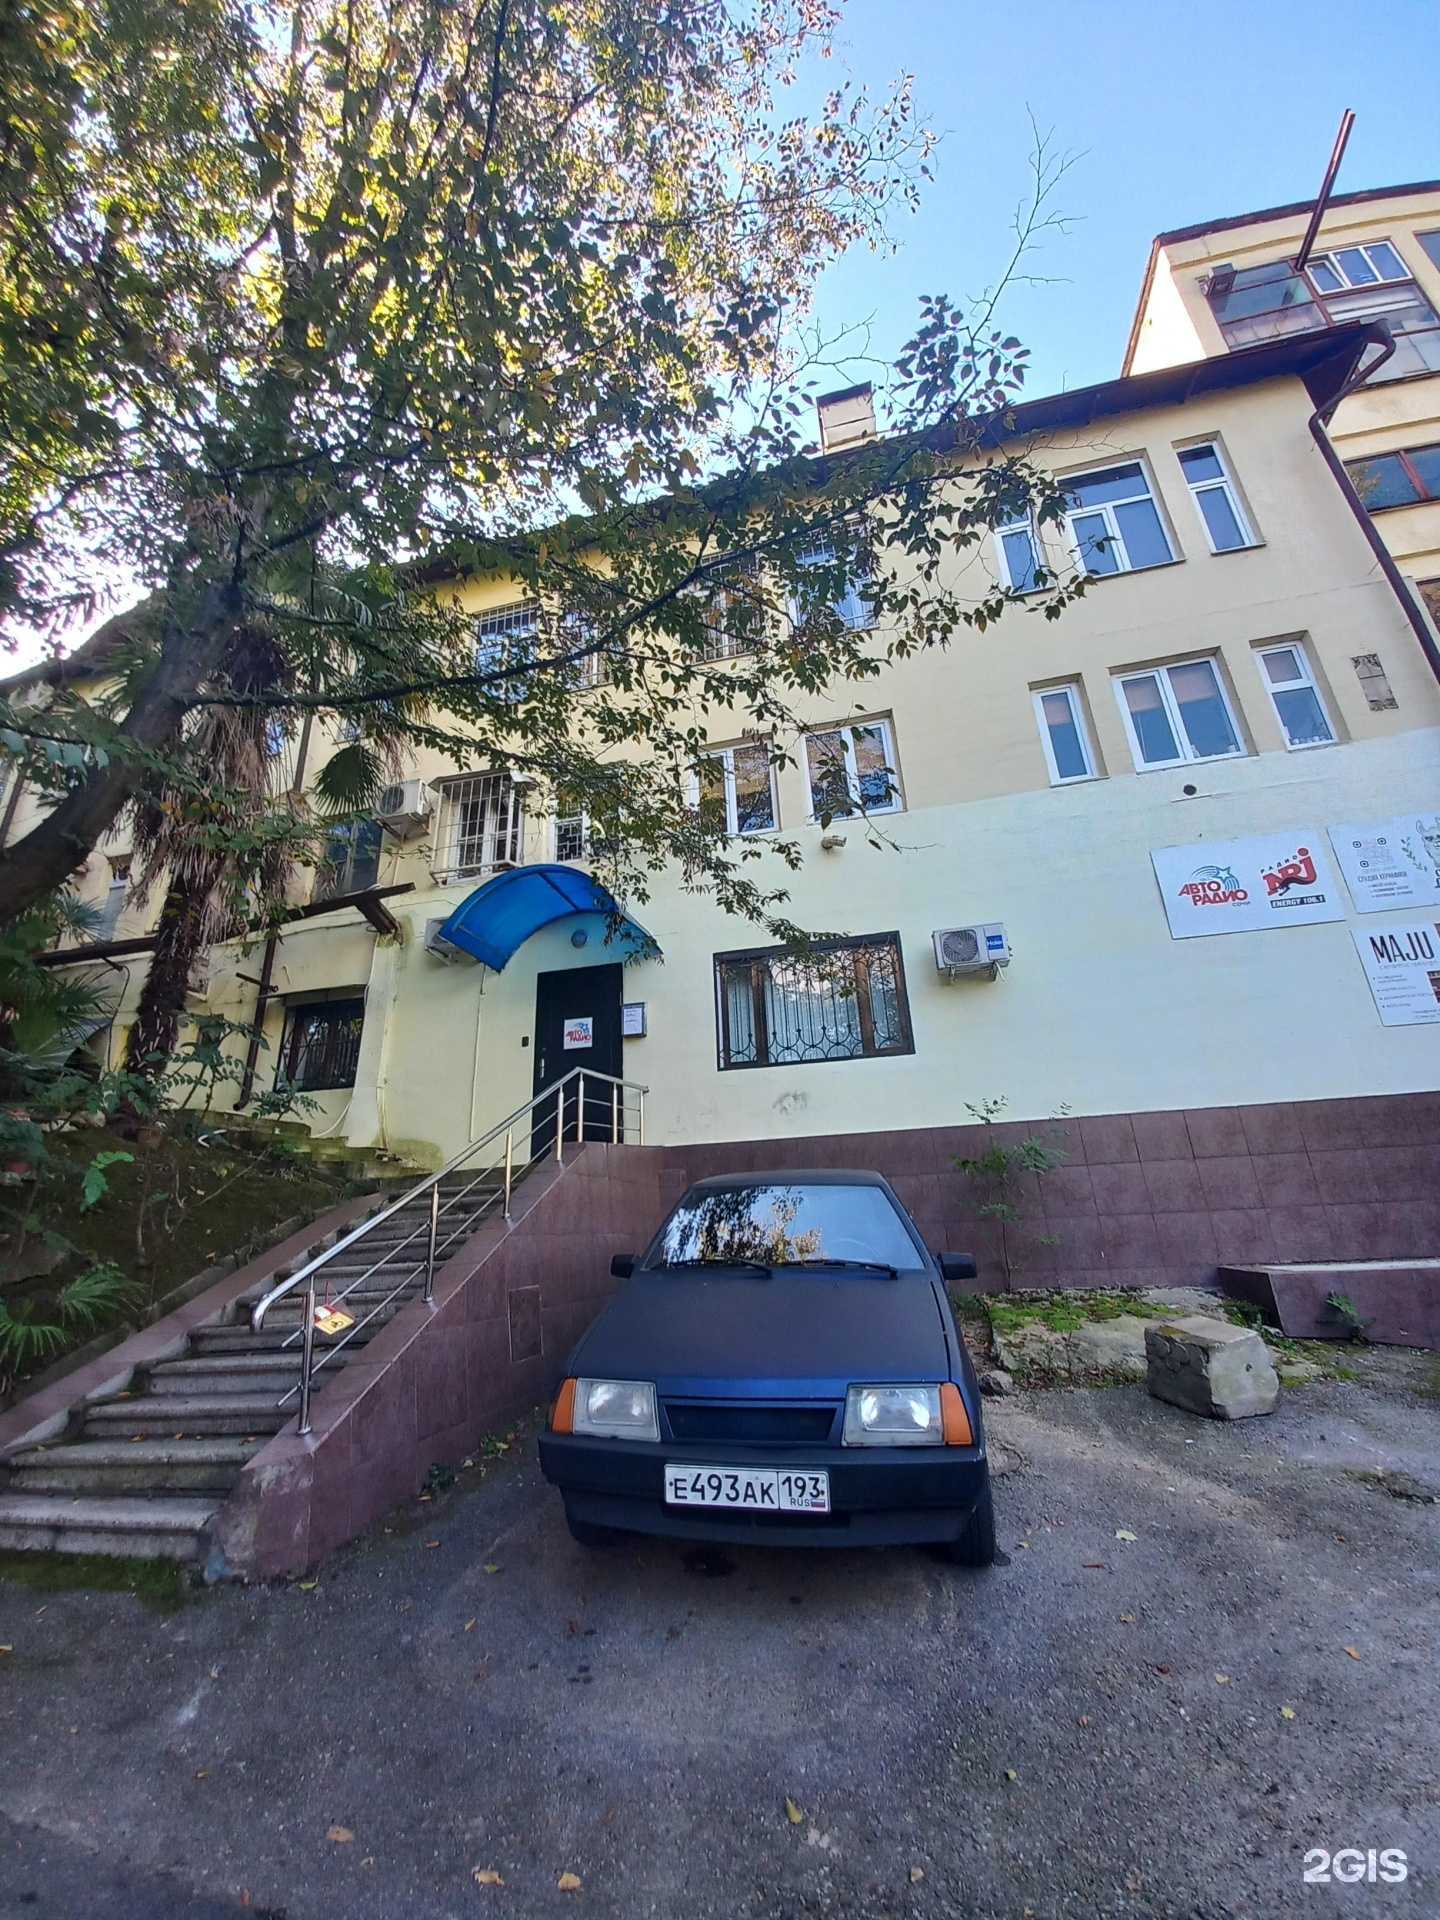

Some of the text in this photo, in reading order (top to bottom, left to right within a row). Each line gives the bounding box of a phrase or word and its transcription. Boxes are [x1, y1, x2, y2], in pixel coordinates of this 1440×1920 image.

[1178, 880, 1222, 897] АВТО
[1191, 888, 1248, 907] РАДИО
[1272, 899, 1301, 908] ENERGY
[1369, 931, 1435, 964] MAJU
[781, 1476, 820, 1498] 193
[790, 1498, 810, 1507] RUS
